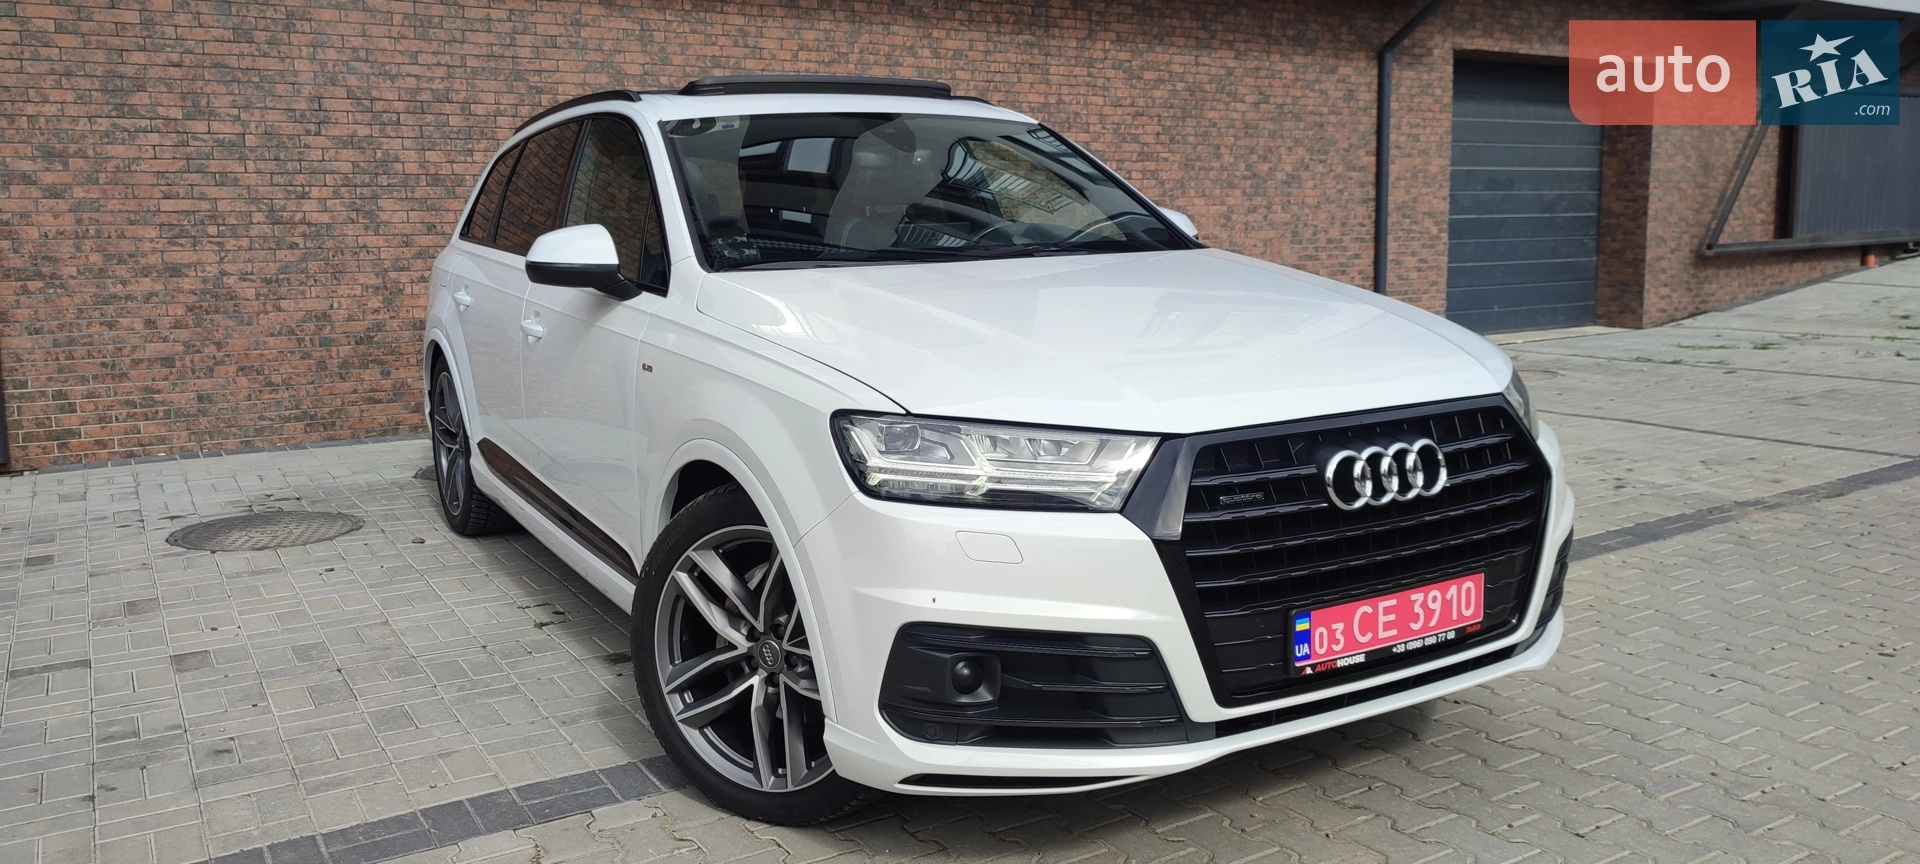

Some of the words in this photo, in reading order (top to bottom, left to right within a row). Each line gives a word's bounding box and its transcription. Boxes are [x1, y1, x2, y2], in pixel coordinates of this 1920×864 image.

[1314, 622, 1345, 655] 03
[1353, 599, 1398, 643] CE
[1408, 581, 1476, 631] 3910
[1295, 644, 1310, 657] UA
[1391, 643, 1406, 653] +38
[1437, 632, 1446, 642] 77
[1315, 653, 1366, 672] AUTOHOUSE
